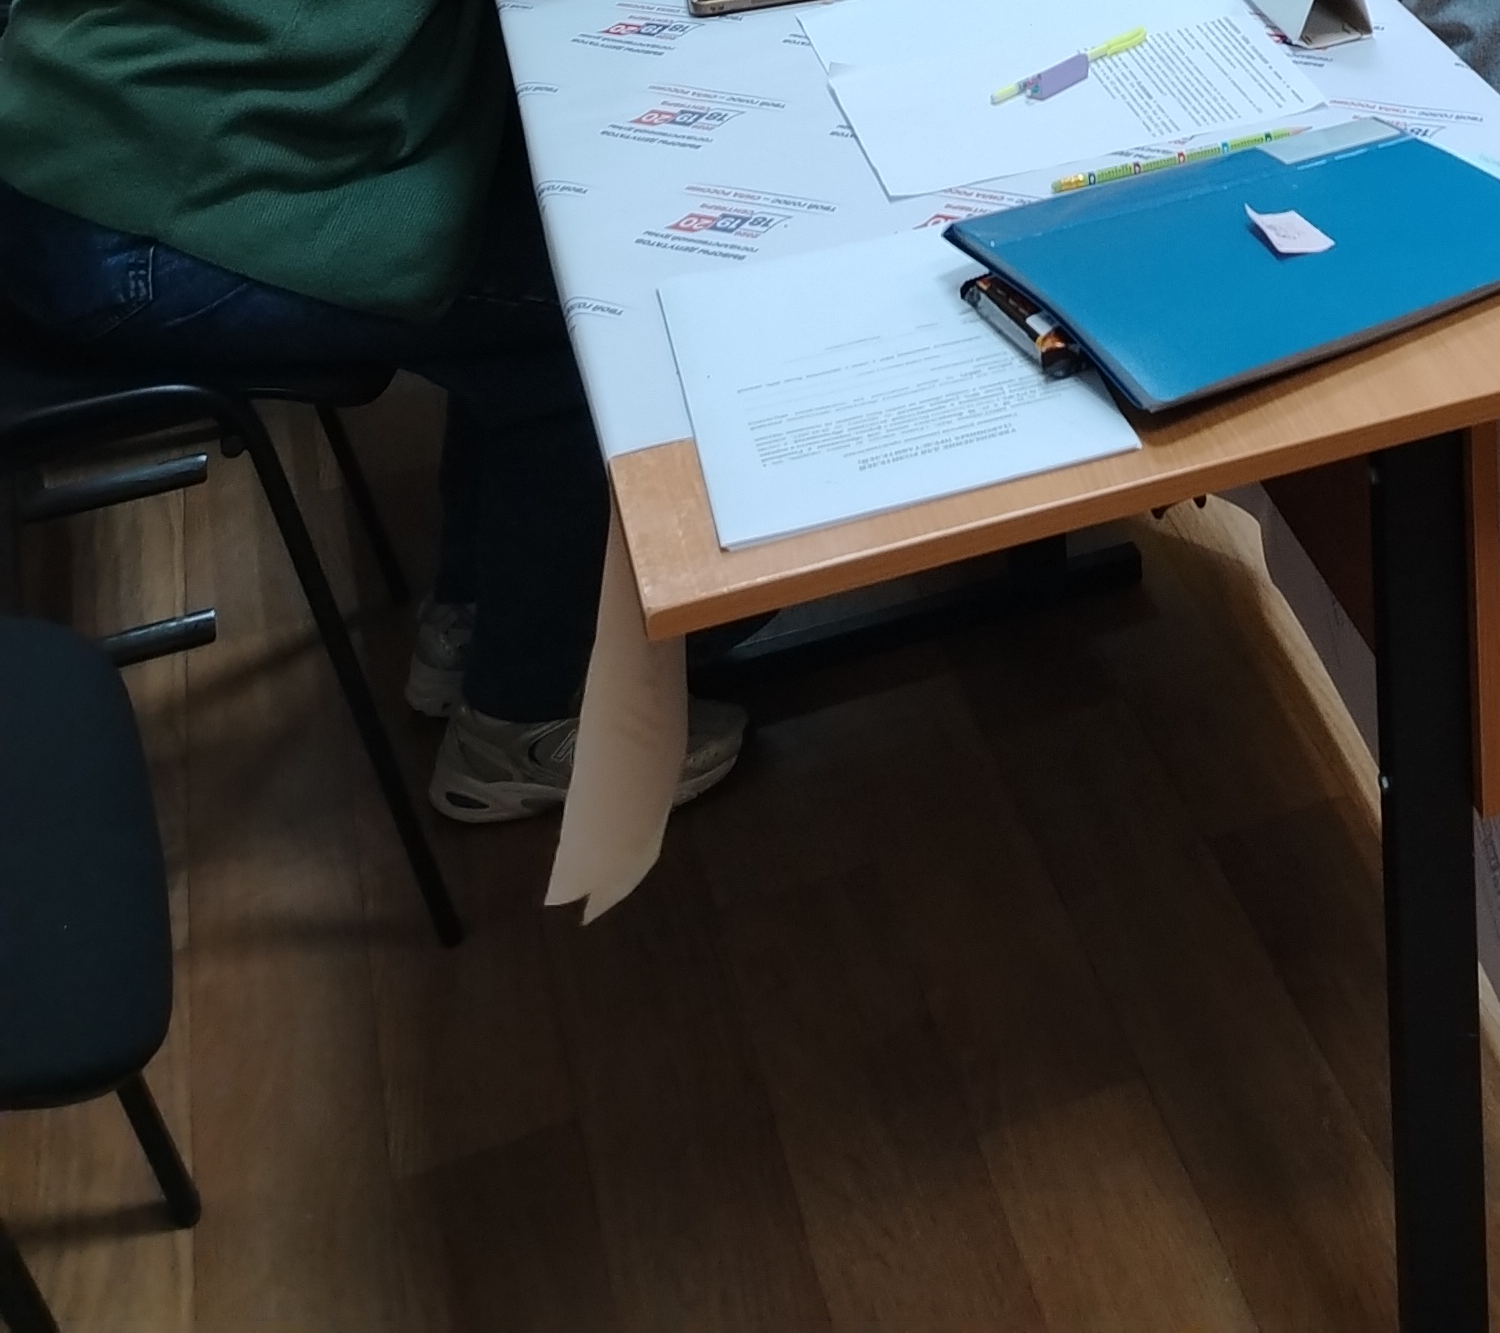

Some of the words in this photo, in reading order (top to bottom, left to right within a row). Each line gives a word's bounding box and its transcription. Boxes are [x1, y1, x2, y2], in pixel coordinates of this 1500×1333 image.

[609, 24, 640, 34] 20
[668, 24, 689, 33] 18
[640, 112, 673, 123] 20
[705, 112, 729, 122] 18
[699, 203, 755, 215] СЕНТЯБРЯ
[771, 197, 808, 209] ГОЛОС
[806, 202, 837, 213] ТВОЙ
[680, 216, 714, 230] 20
[716, 214, 741, 229] 19
[749, 216, 774, 228] 18
[635, 238, 700, 255] ДЕПУТАТОВ
[698, 248, 747, 261] ВЫБОРЫ
